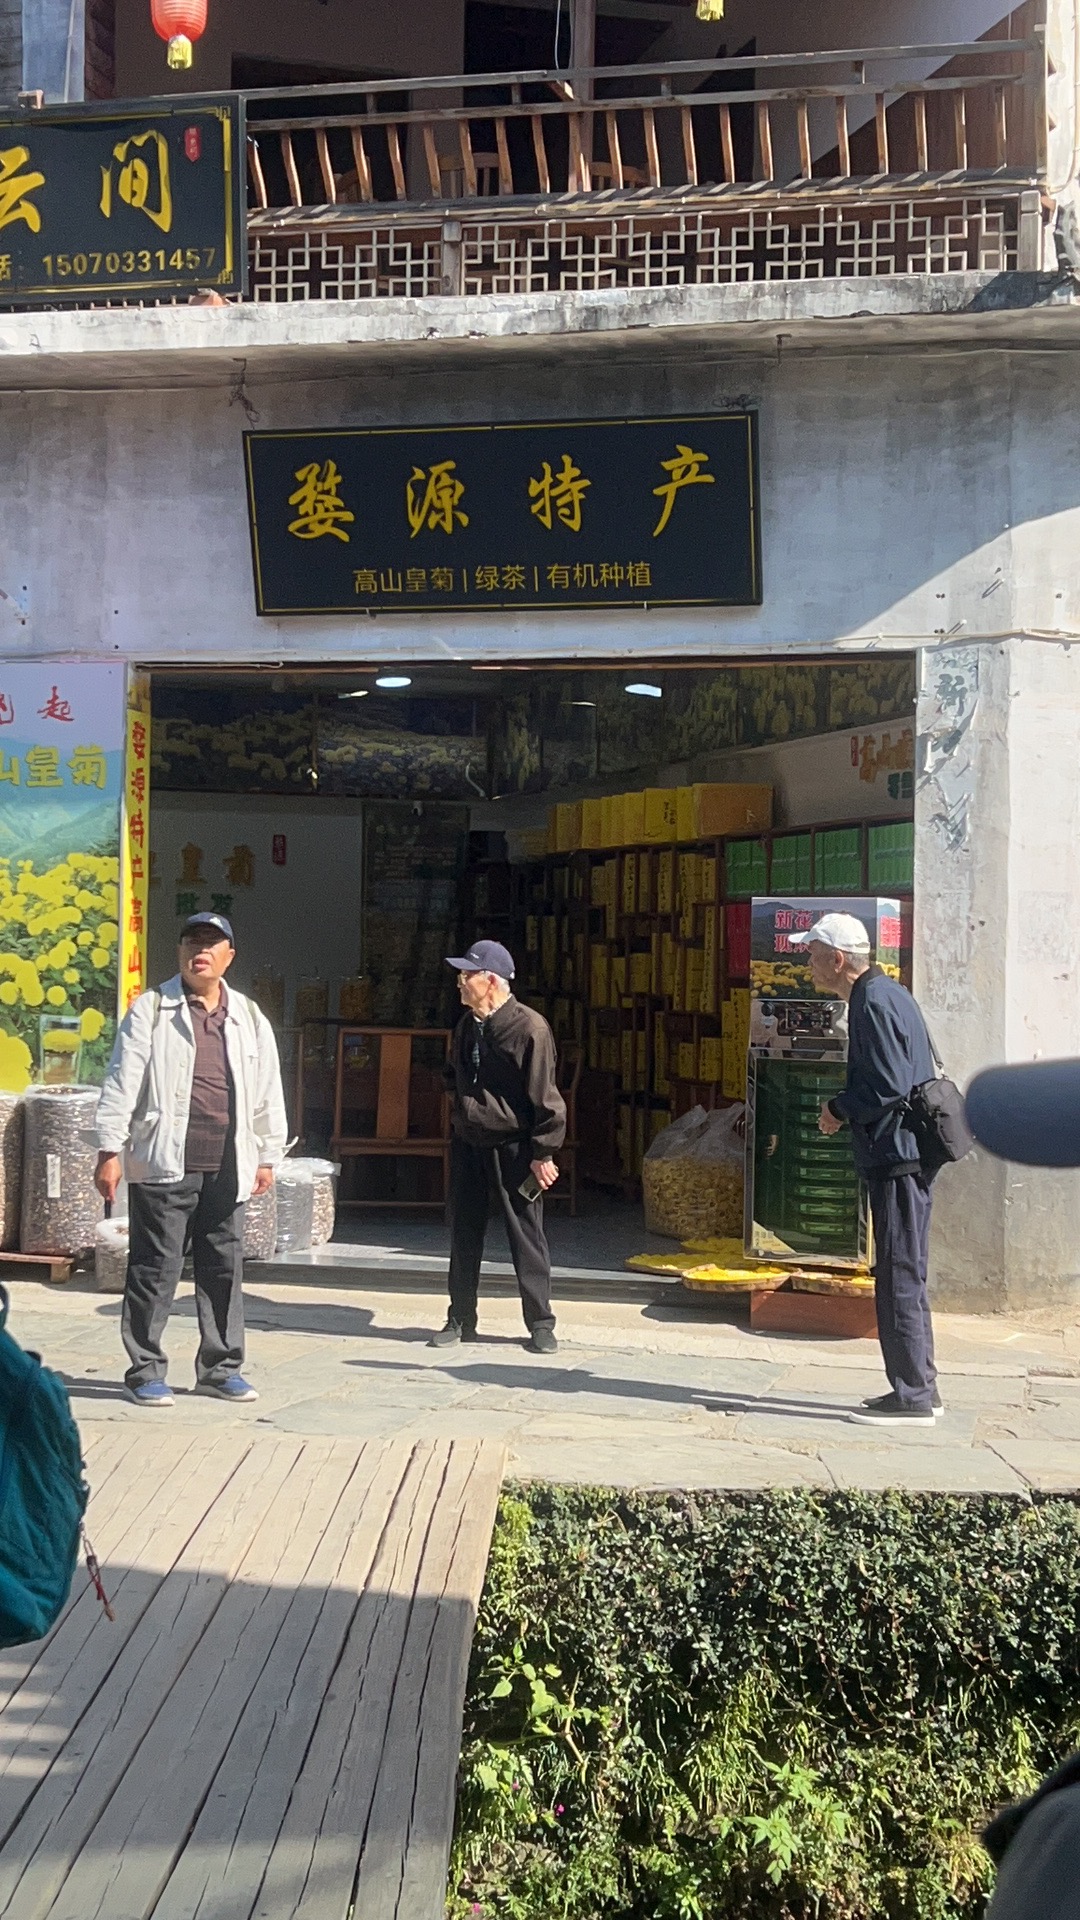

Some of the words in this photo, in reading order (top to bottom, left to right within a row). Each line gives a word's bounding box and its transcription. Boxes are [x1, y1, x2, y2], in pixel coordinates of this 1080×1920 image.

[42, 247, 216, 277] 15070331457
[287, 444, 717, 543] 婺源特产
